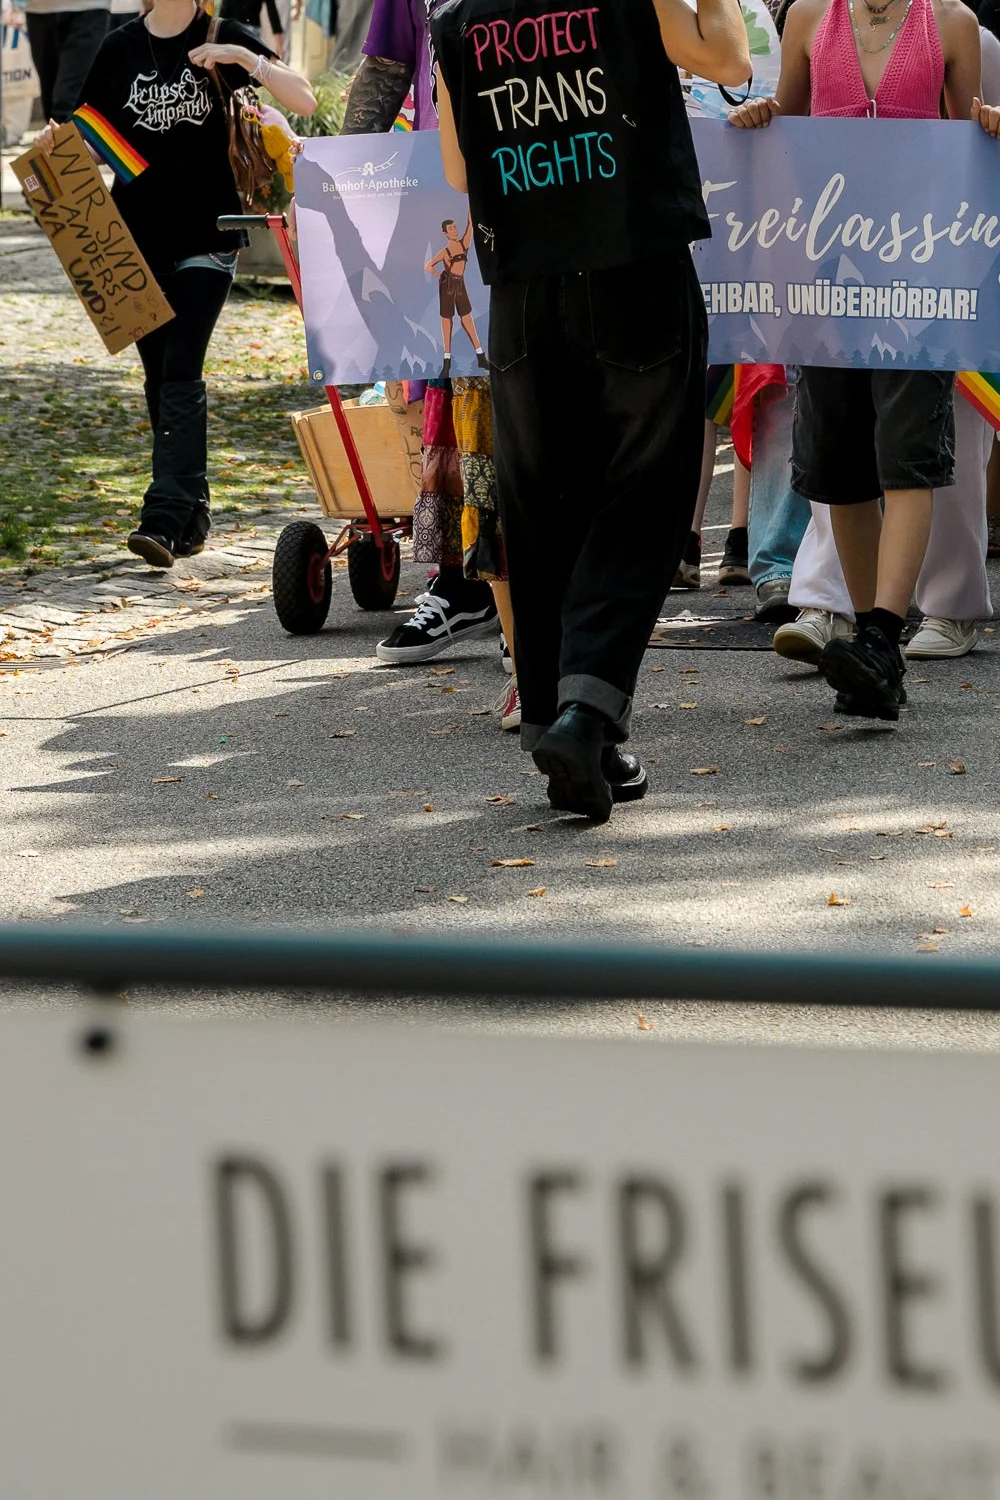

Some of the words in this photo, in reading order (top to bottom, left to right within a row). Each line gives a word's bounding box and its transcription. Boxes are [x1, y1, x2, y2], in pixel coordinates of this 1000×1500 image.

[465, 7, 600, 72] PROTECT
[477, 67, 607, 131] TRANS
[322, 176, 419, 193] Bahnhof-Apotheke
[491, 131, 616, 196] RIGHTS
[32, 197, 66, 239] NA
[51, 134, 106, 222] WIR
[96, 220, 148, 292] SIND
[58, 204, 128, 306] ANDERS!
[701, 282, 781, 317] EHBAR,
[787, 279, 978, 320] UNÜBERHÖRBAR!
[214, 1154, 442, 1362] DIE
